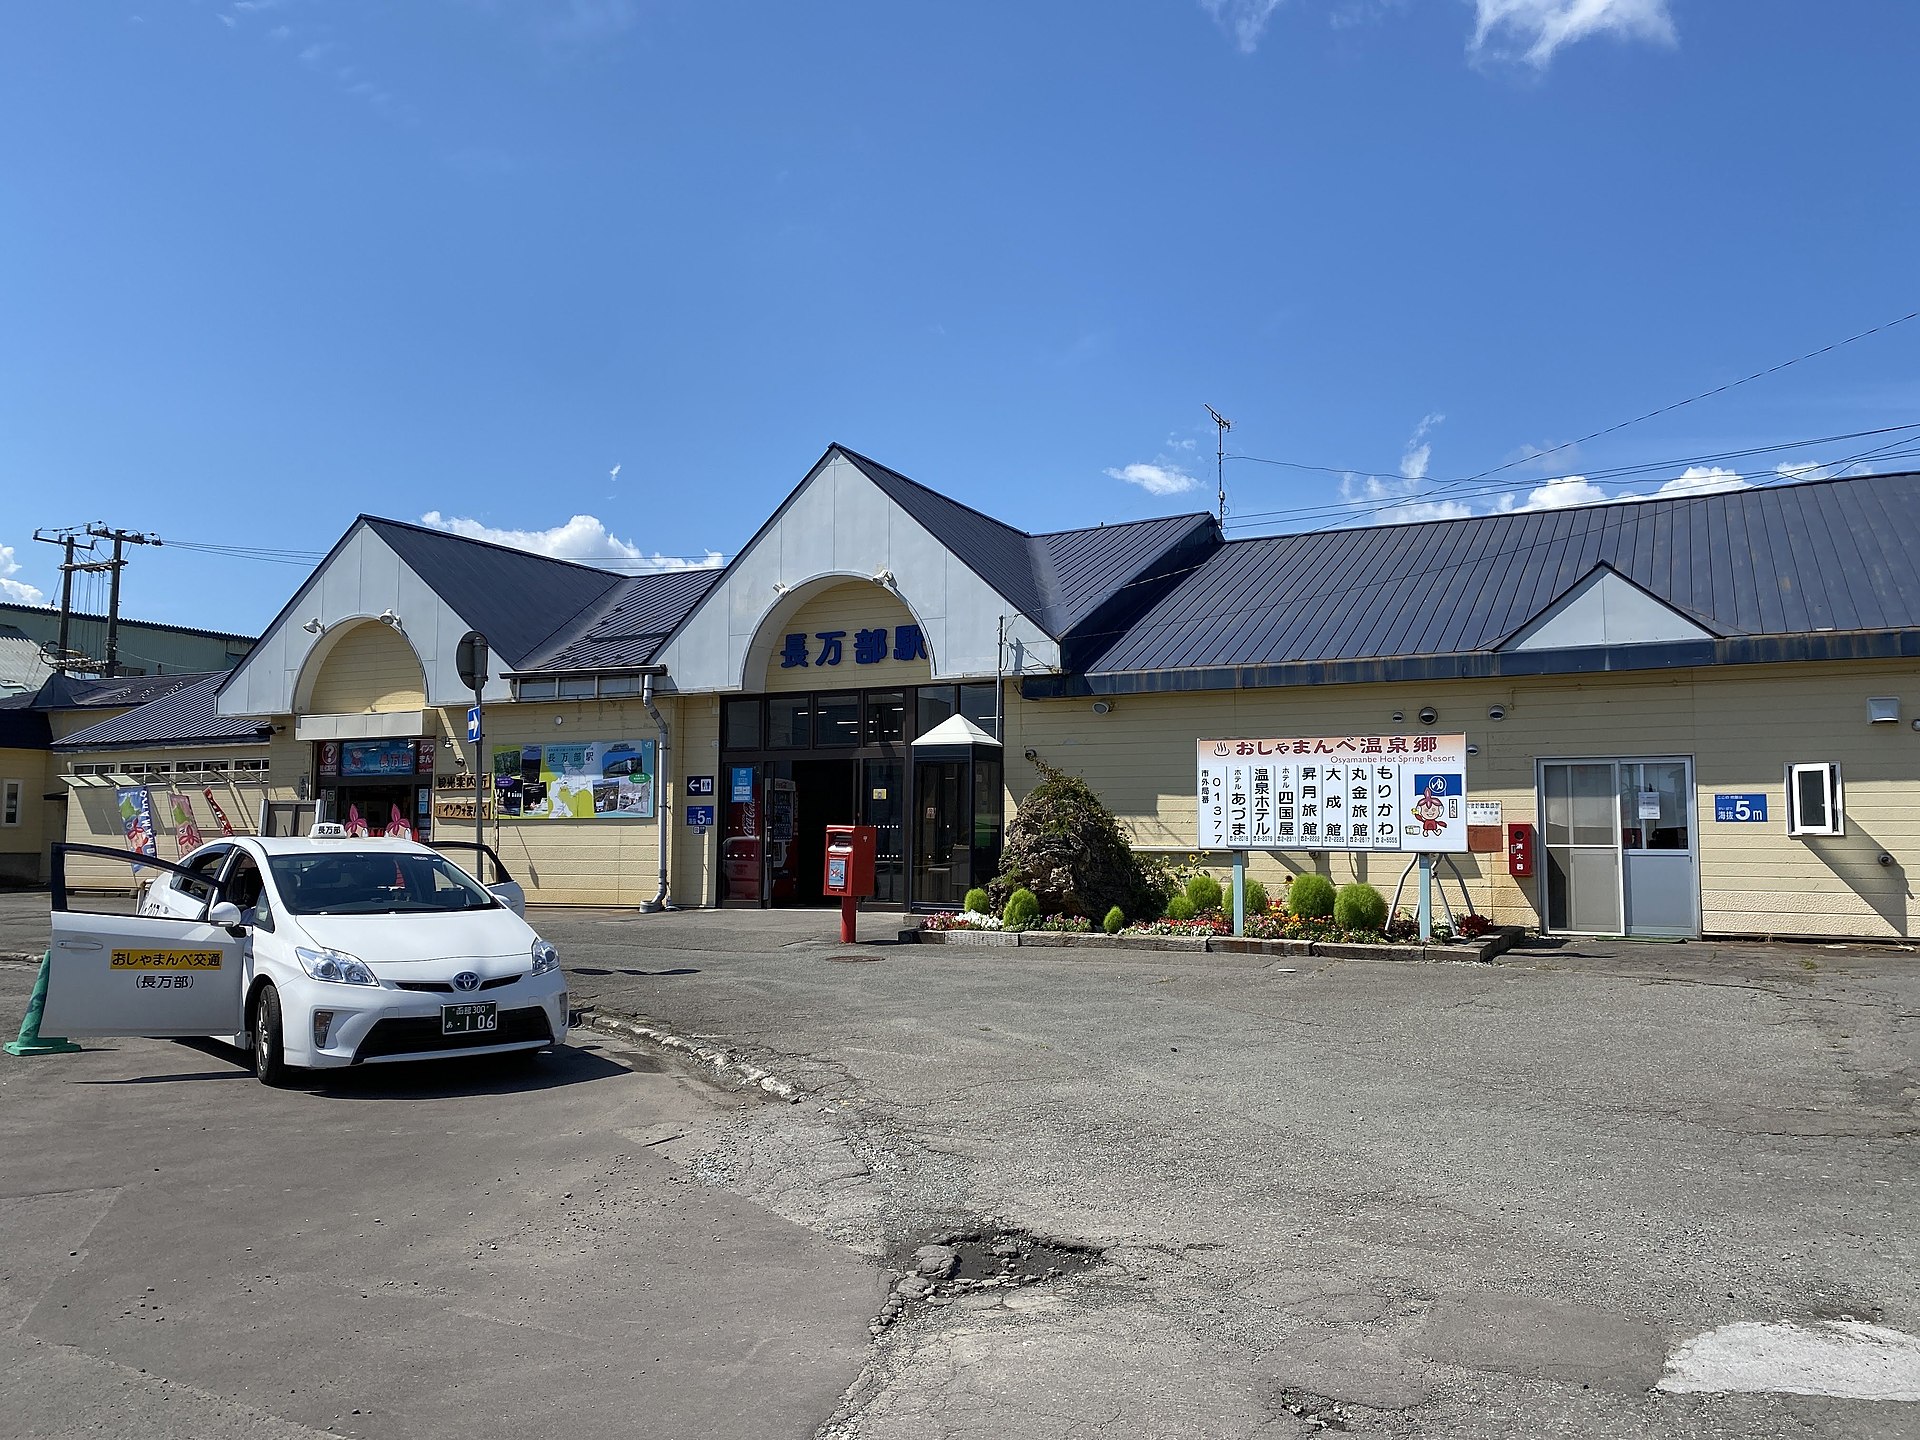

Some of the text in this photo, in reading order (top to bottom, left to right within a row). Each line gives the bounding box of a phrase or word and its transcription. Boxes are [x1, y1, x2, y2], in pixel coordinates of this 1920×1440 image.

[780, 624, 928, 668] 長万部駅
[548, 752, 594, 762] 長万部駅
[1236, 736, 1438, 756] おしゃまんべ温泉郷
[1330, 756, 1377, 764] Osyamanbe
[1398, 755, 1424, 764] Spring
[1427, 754, 1456, 762] Resort
[1202, 770, 1210, 804] 市外局番
[1254, 768, 1270, 836] 温泉ホテル
[1302, 767, 1318, 836] 昇月旅館
[1326, 768, 1342, 836] 大成館
[1352, 768, 1368, 837] 丸金旅館
[1377, 766, 1394, 836] もりかわ
[1432, 778, 1444, 790] ゆ
[318, 826, 341, 834] 長万部
[1212, 778, 1222, 844] 01377
[112, 952, 220, 966] おしゃまんべ交通
